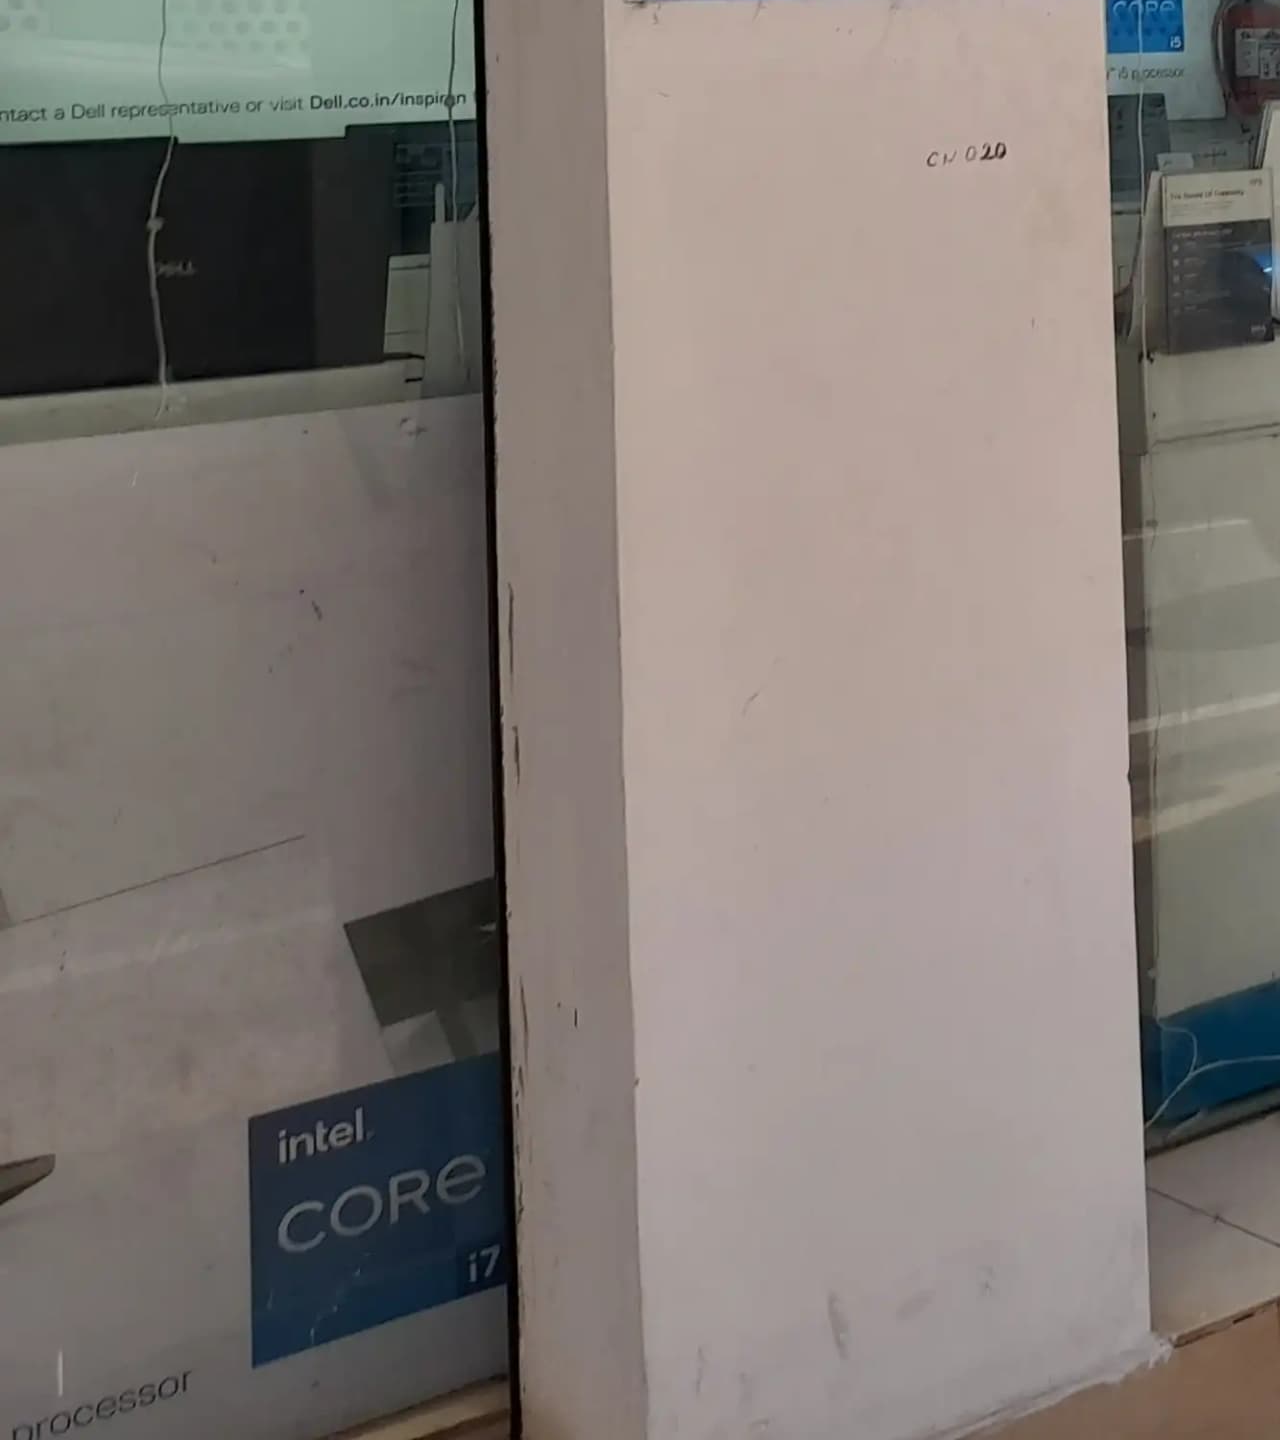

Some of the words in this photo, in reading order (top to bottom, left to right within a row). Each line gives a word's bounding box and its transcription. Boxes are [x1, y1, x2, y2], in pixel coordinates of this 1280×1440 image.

[54, 107, 65, 120] a
[71, 103, 105, 119] Dell
[110, 95, 241, 120] representative
[245, 99, 265, 113] or
[269, 96, 304, 112] visit
[278, 1108, 366, 1164] intel
[469, 1243, 501, 1283] i7
[11, 1369, 192, 1440] processor
